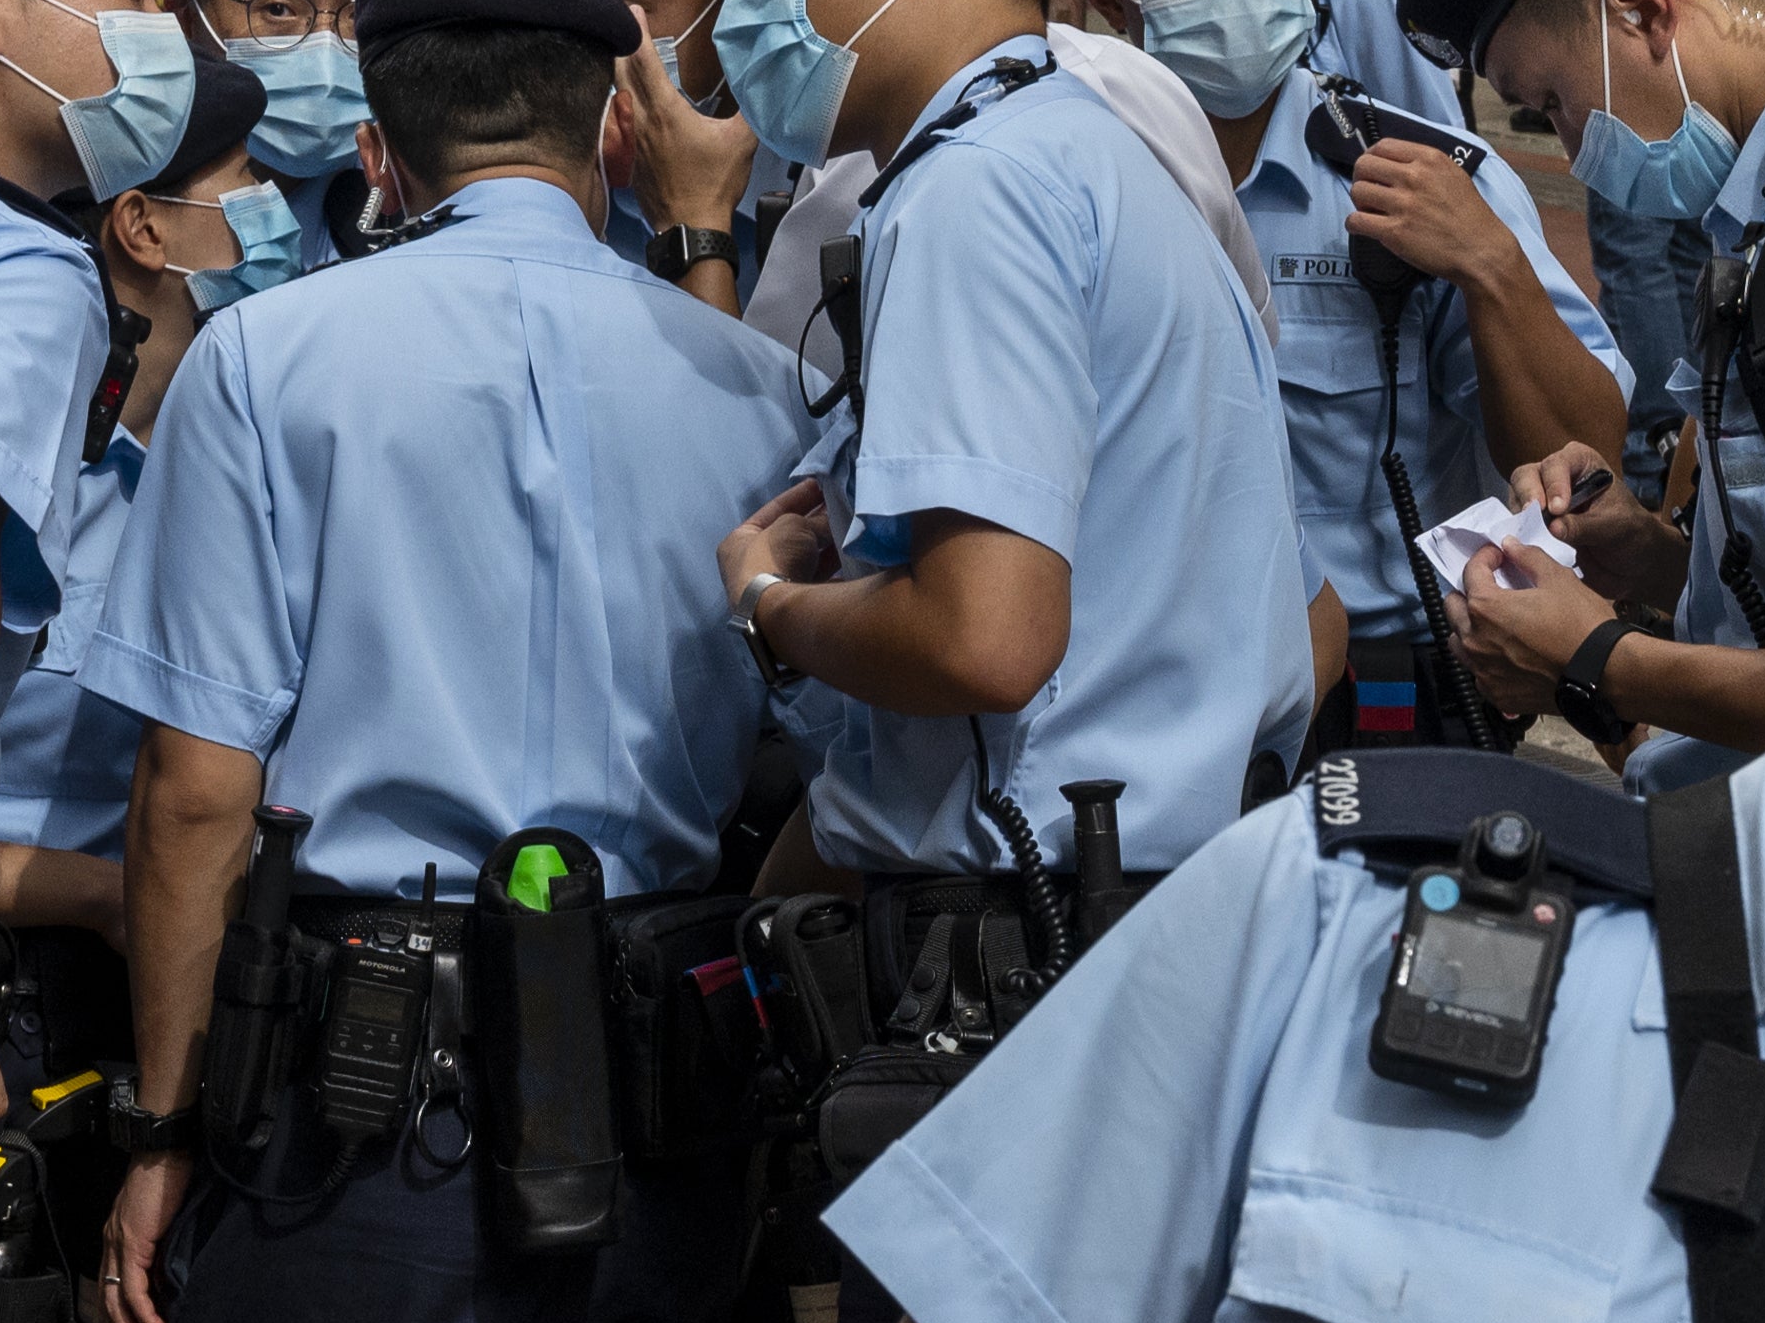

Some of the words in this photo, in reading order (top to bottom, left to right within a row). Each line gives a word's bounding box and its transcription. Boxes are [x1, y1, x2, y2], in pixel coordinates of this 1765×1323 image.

[1278, 257, 1299, 278] 警
[1304, 258, 1353, 279] POLI
[1318, 757, 1362, 827] 27099
[357, 958, 407, 974] MOTOROLA
